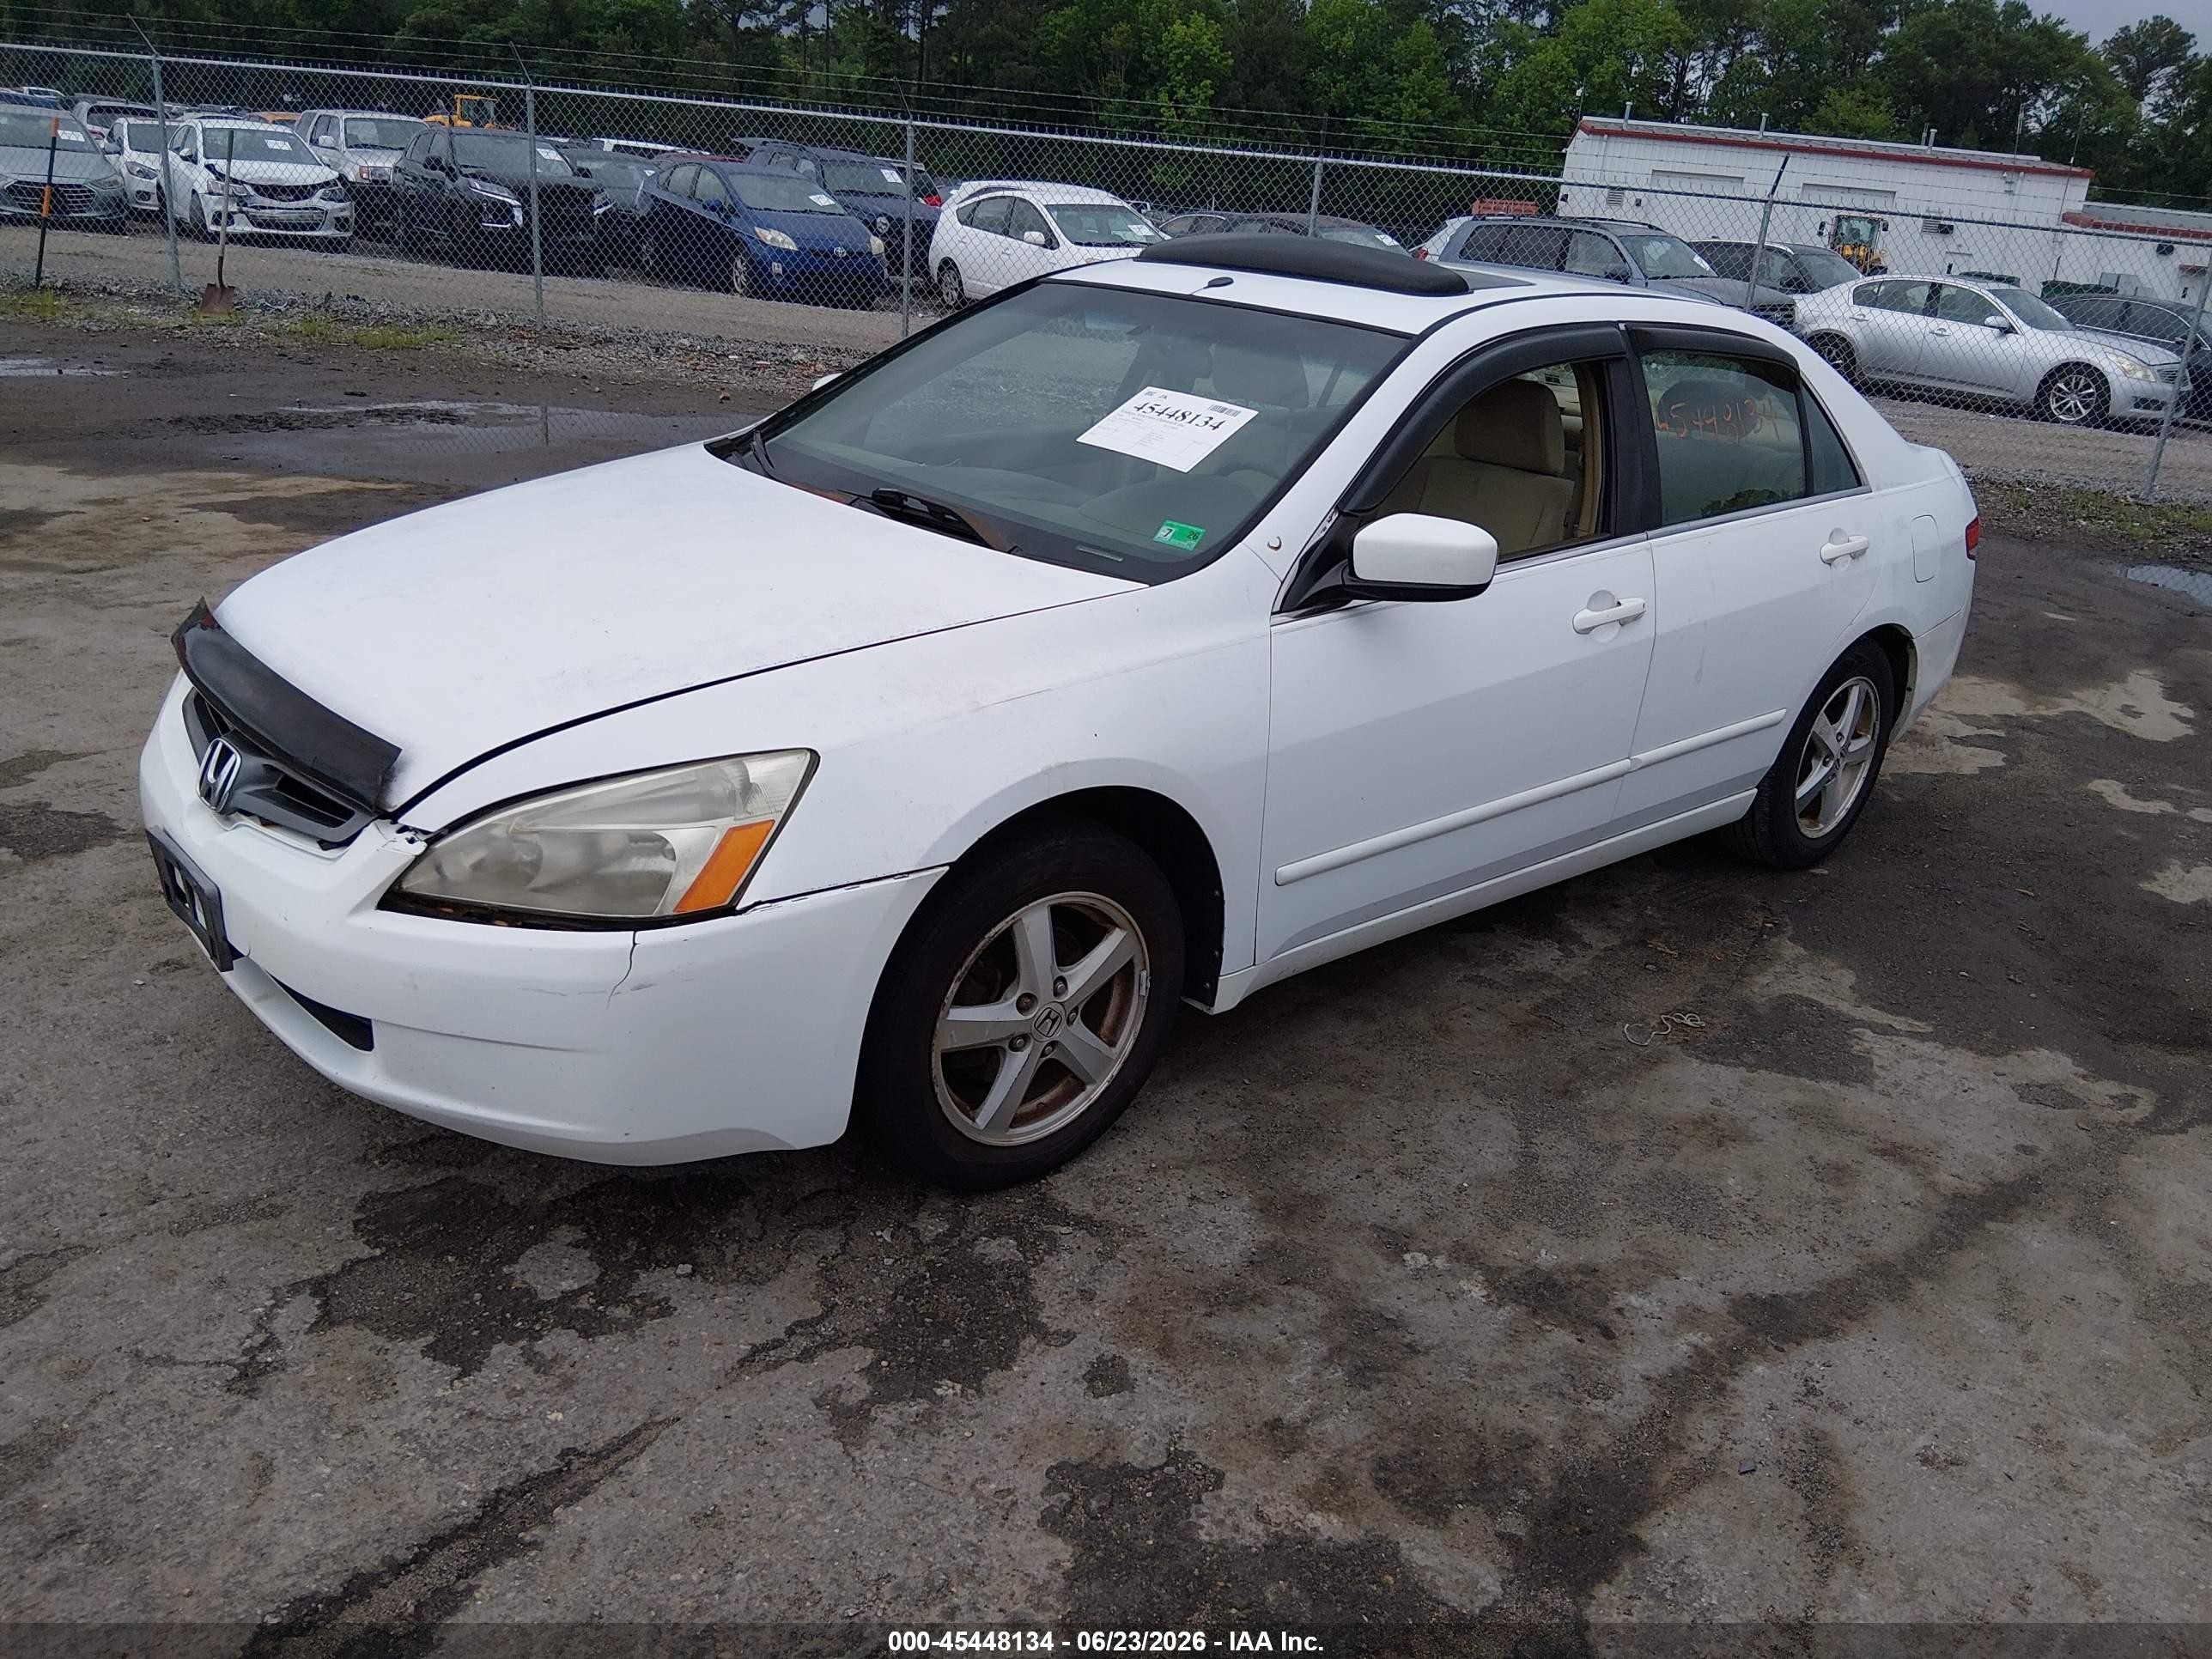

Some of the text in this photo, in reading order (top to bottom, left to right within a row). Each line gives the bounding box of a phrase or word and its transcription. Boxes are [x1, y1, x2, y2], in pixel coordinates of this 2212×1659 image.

[1133, 402, 1225, 430] 45448134
[1163, 528, 1200, 541] 7 26
